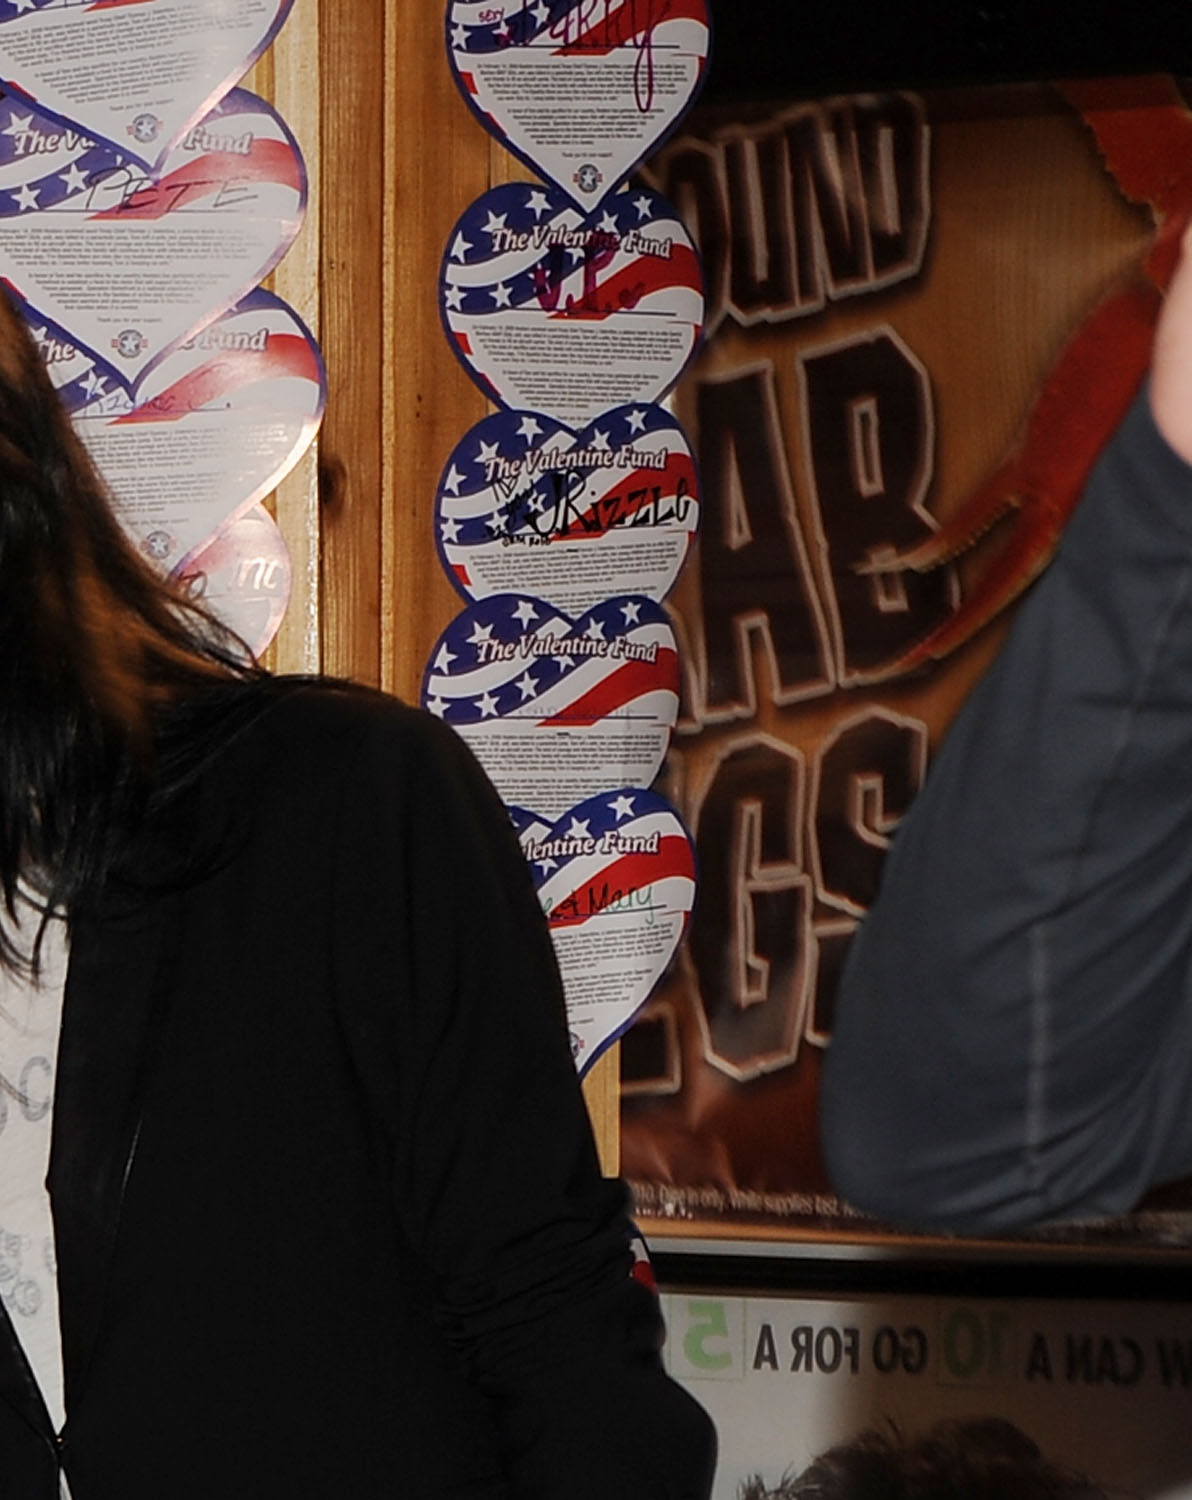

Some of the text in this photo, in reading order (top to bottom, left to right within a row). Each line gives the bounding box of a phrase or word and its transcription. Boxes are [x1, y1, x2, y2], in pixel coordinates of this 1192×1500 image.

[14, 131, 59, 155] The
[184, 130, 253, 155] Fund
[493, 224, 672, 258] The Valentine Fund
[485, 444, 667, 482] The Valentine Fund
[477, 632, 658, 663] The Valentine Fund
[523, 830, 661, 861] lentine Fund
